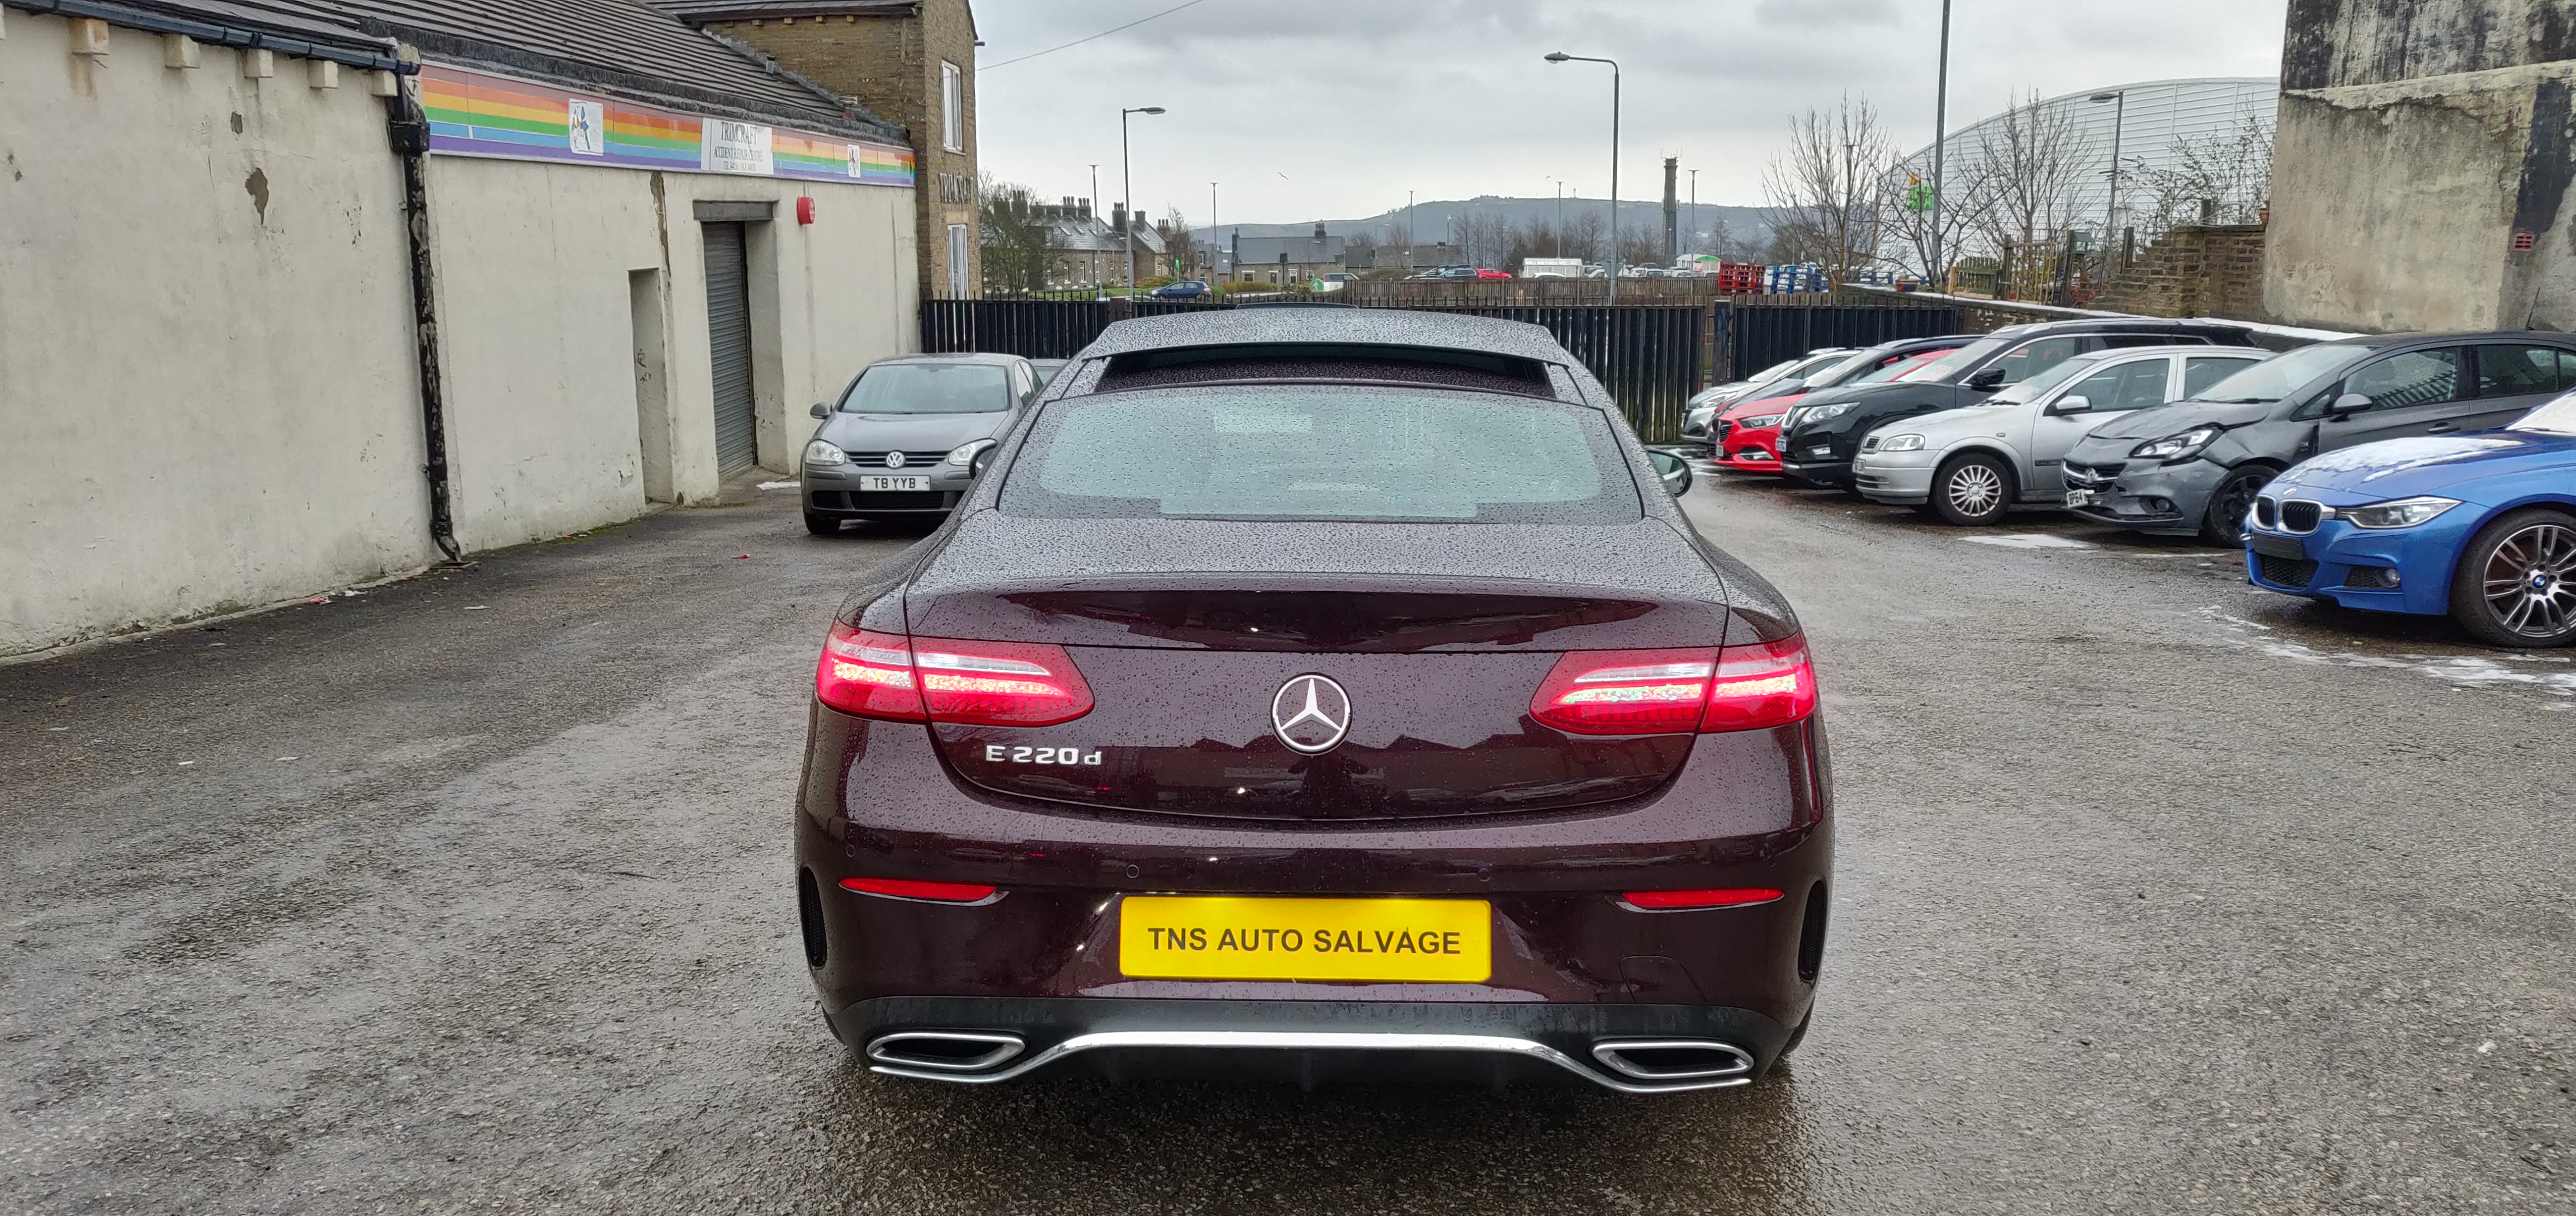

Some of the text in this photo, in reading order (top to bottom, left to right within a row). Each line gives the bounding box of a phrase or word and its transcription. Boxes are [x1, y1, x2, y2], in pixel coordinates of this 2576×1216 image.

[721, 121, 757, 145] TRIMCRAFT
[892, 478, 916, 489] YYB
[986, 745, 1006, 762] E
[1148, 928, 1460, 954] TNS AUTO SALVAGE
